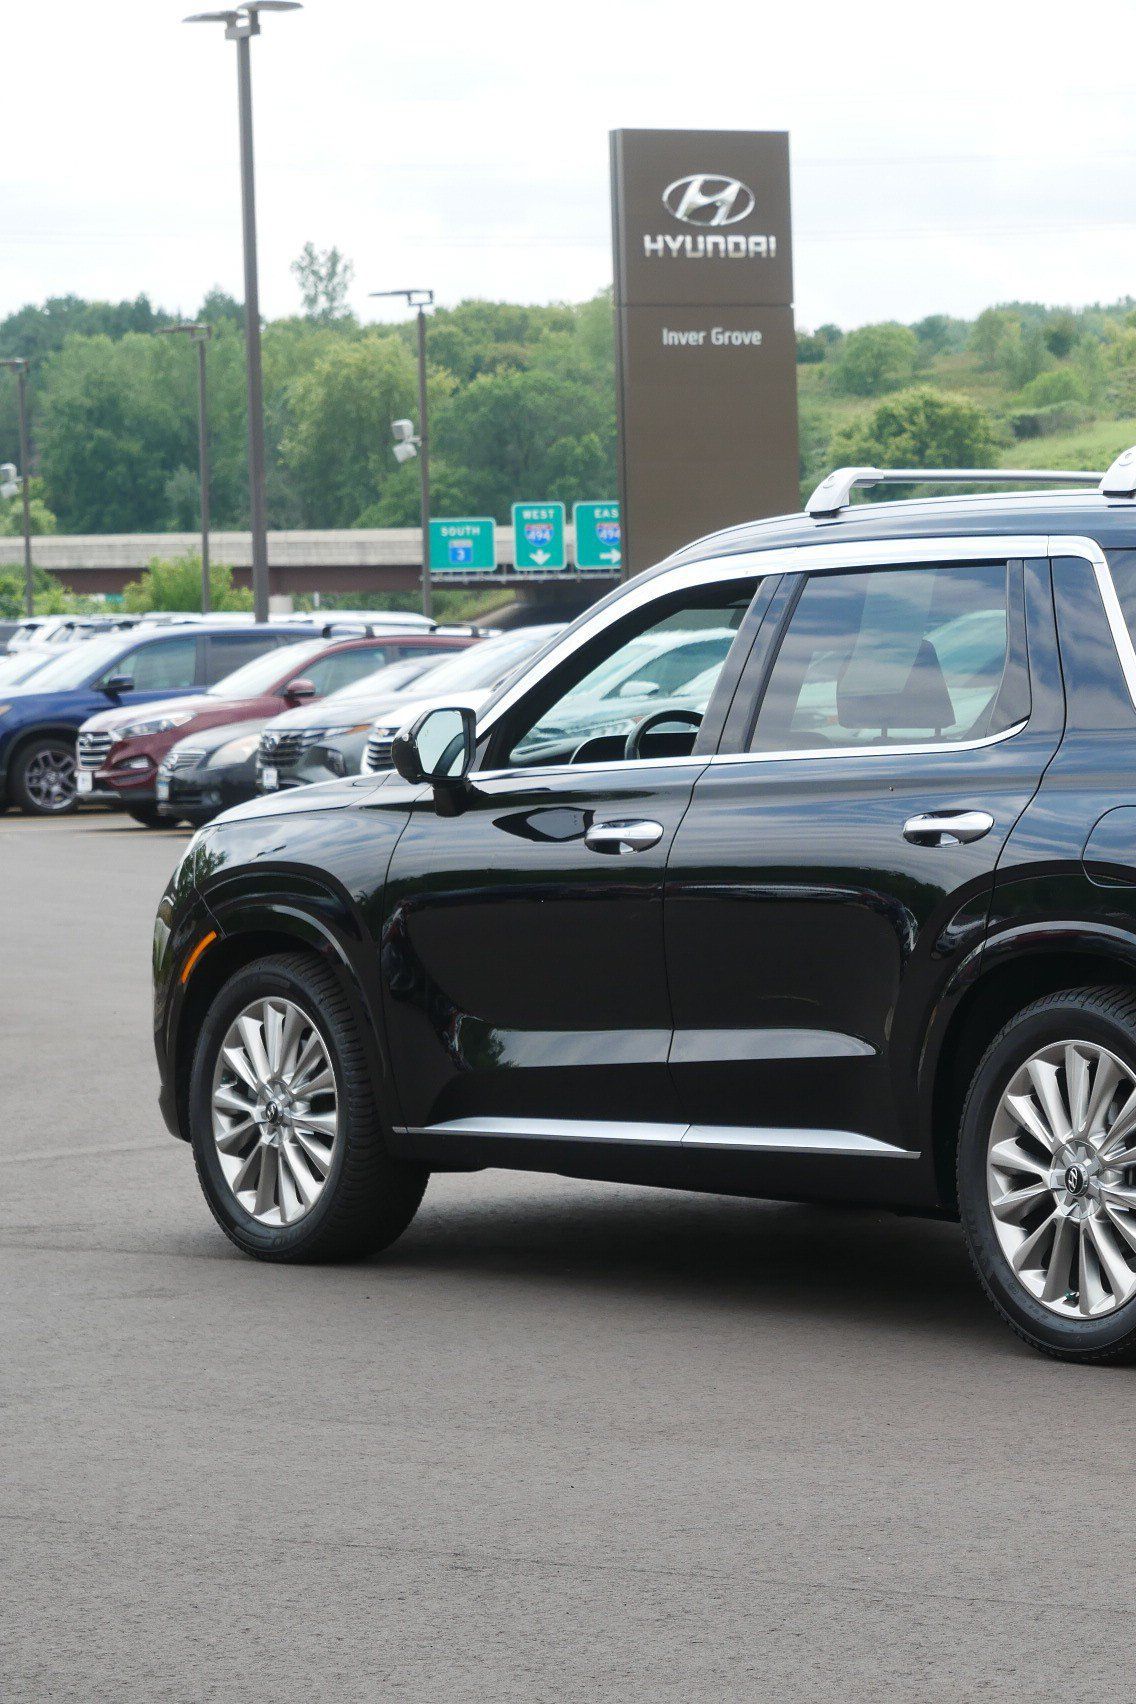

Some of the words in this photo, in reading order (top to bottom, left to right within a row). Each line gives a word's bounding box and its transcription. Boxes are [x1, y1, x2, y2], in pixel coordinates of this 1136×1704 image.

[643, 234, 777, 258] HYUNDAI
[662, 327, 706, 346] Inver
[710, 326, 763, 346] Grove
[523, 510, 555, 520] WEST
[595, 508, 620, 519] EAS
[441, 527, 480, 536] SOUTH
[457, 551, 465, 562] 3
